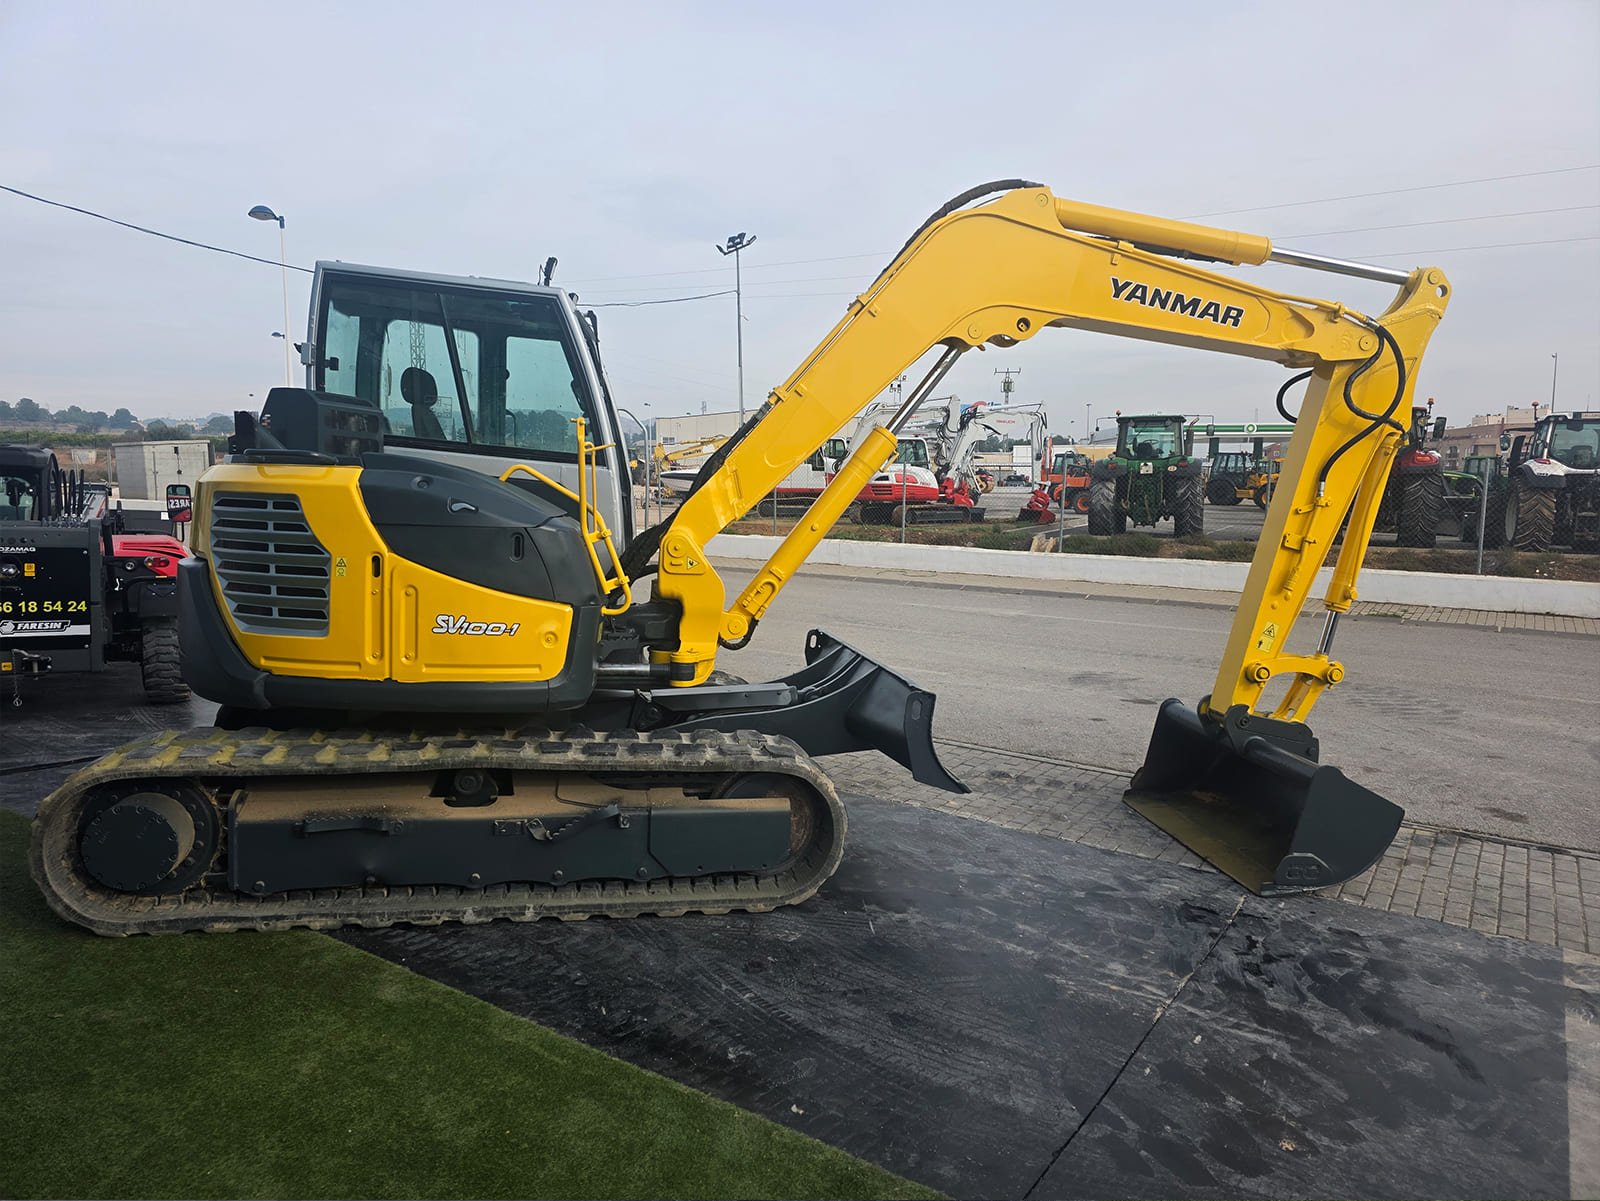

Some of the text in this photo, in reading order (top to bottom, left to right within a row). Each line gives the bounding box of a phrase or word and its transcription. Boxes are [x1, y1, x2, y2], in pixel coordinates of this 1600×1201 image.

[1111, 277, 1244, 327] YANMAR
[0, 600, 87, 613] 6 18 54 24
[17, 621, 62, 630] FARESIN
[432, 614, 520, 636] SV100-1
